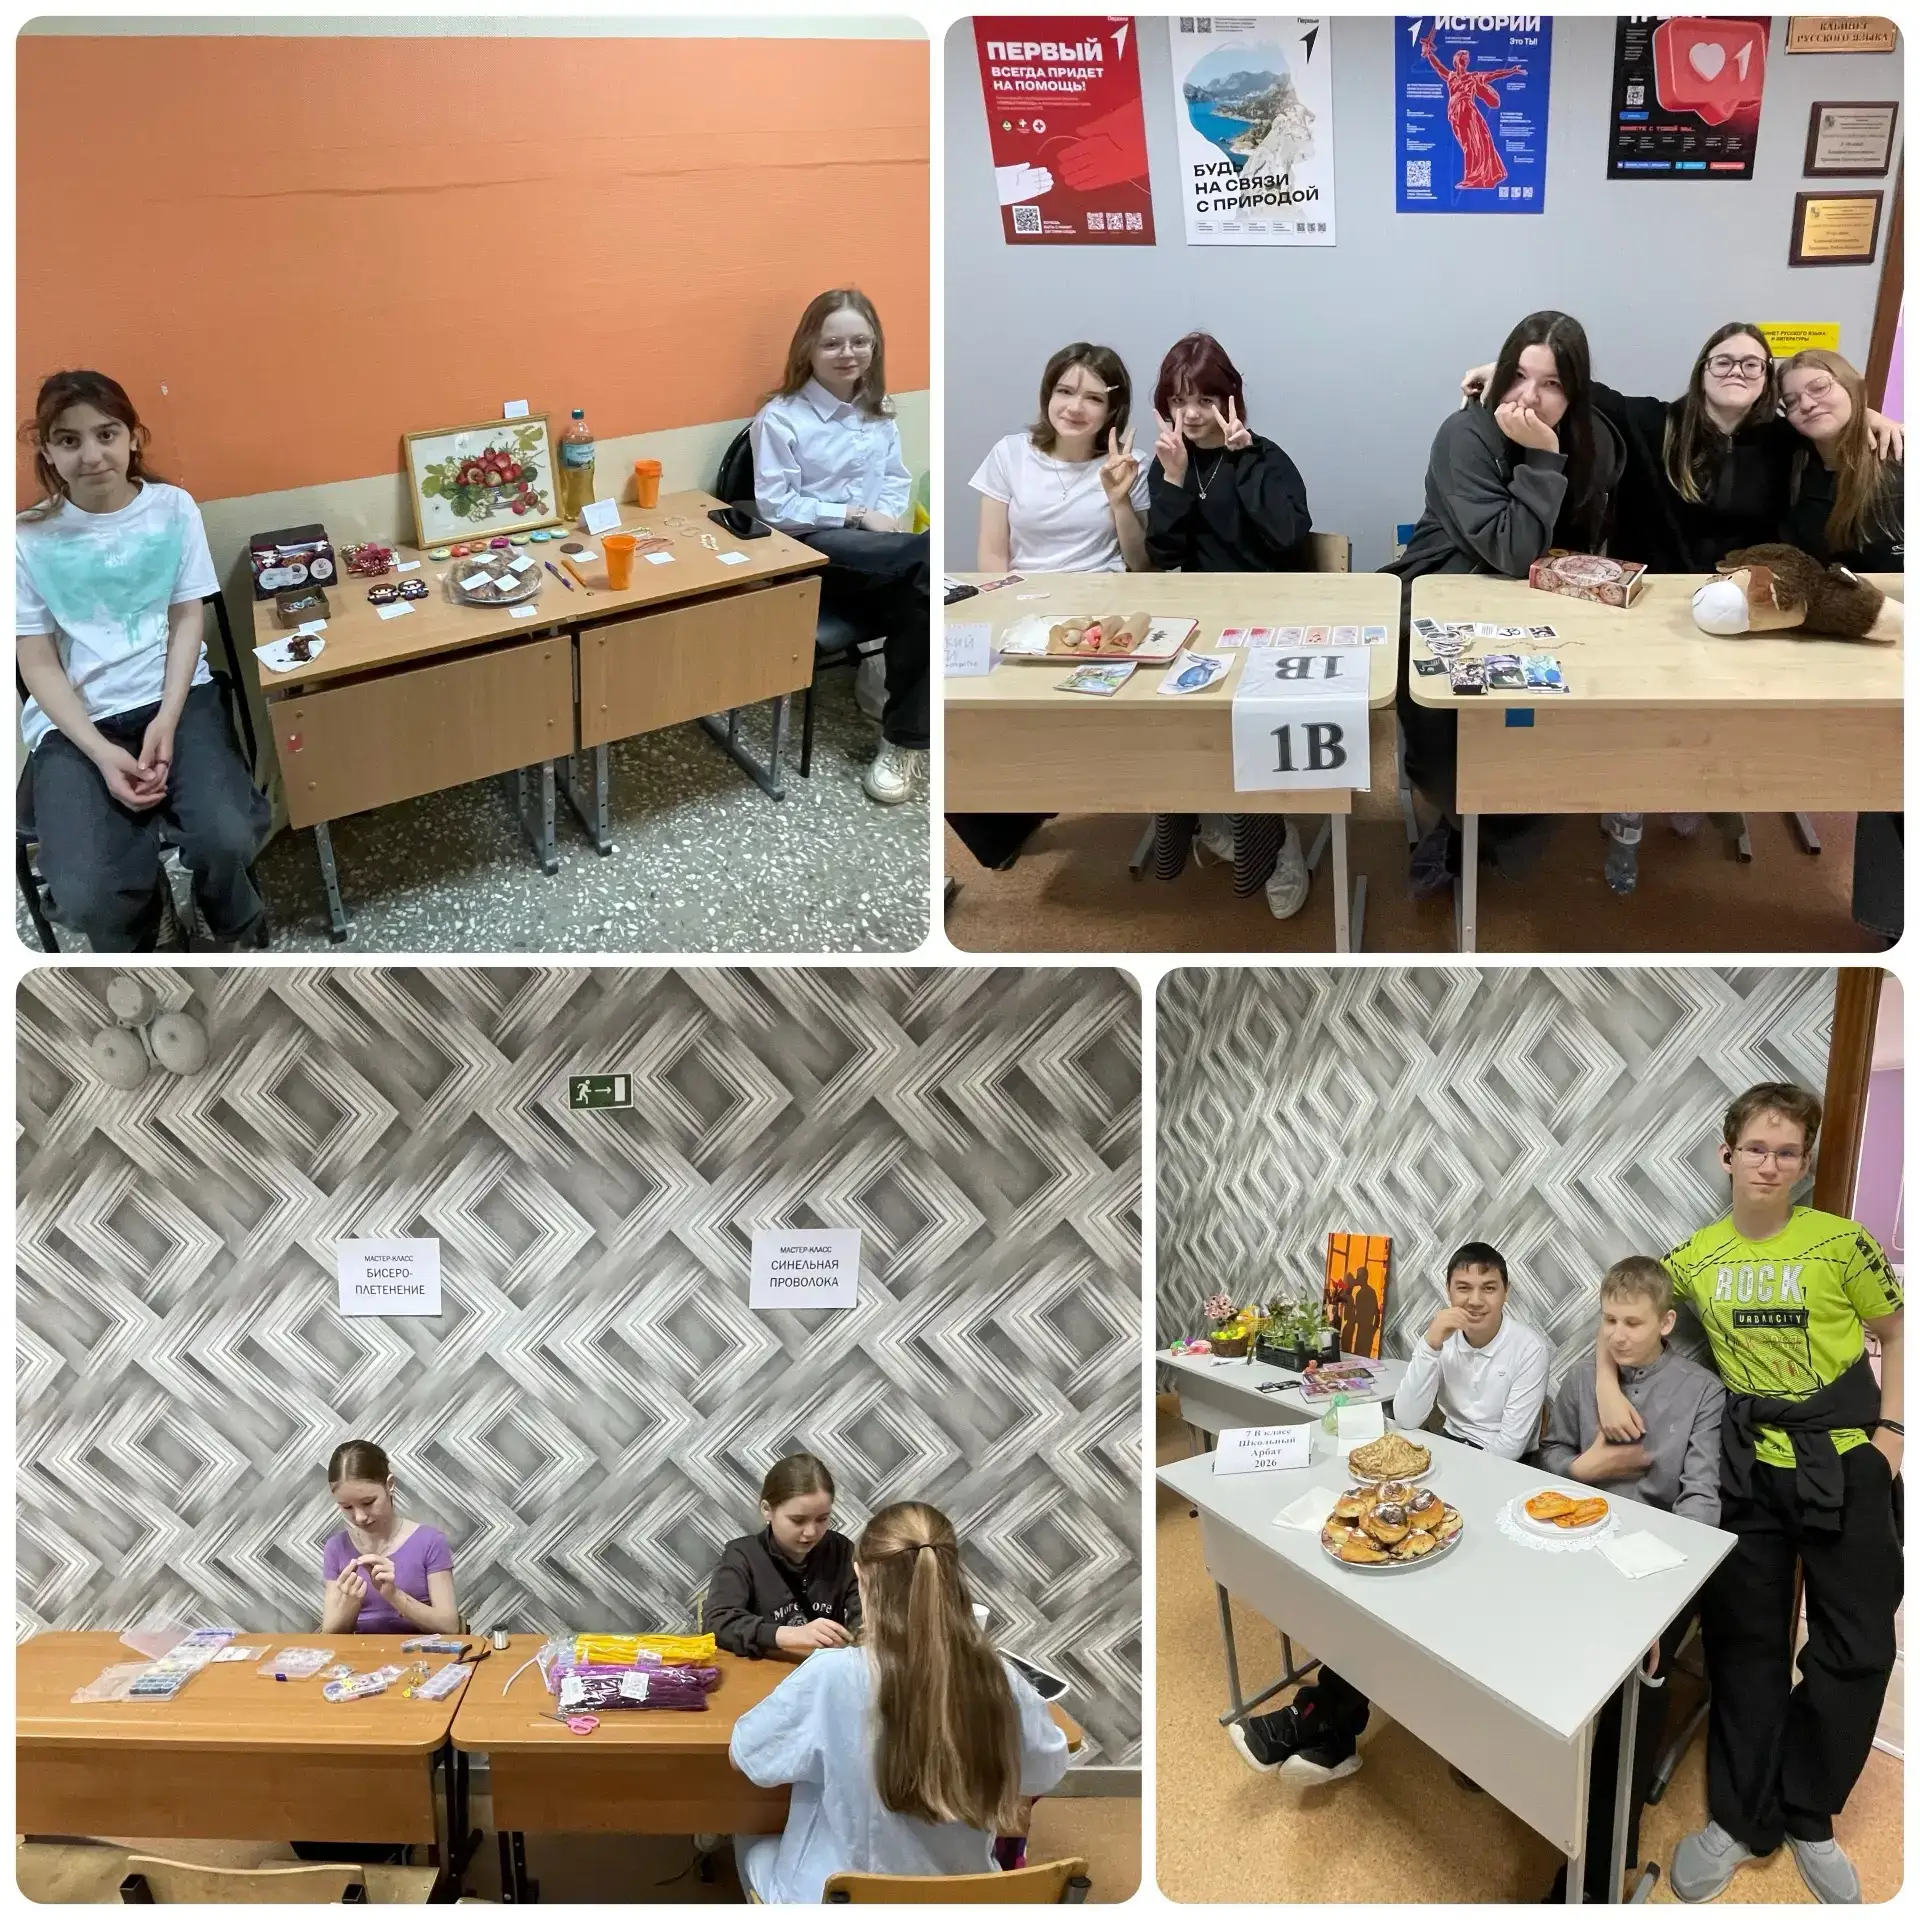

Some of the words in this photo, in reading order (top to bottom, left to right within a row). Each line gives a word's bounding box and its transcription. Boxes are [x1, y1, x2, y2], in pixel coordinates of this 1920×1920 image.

[1434, 16, 1541, 32] ИСТОРИИ
[1510, 37, 1523, 45] Это
[1797, 33, 1849, 43] РУССКОГО
[1852, 33, 1888, 42] ЯЗЫКА
[987, 37, 1103, 61] ПЕРВЫЙ
[991, 66, 1046, 79] ВСЕГДА
[1048, 67, 1104, 79] ПРИДЕТ
[993, 80, 1013, 91] НА
[1015, 80, 1087, 92] ПОМОЩЬ!
[1194, 160, 1243, 177] БУДЬ
[1195, 181, 1222, 195] НА
[1225, 174, 1289, 191] СВЯЗИ
[1196, 200, 1209, 213] С
[1213, 185, 1319, 211] ПРИРОДОЙ
[779, 1246, 832, 1254] МАСТЕР-КЛАСС
[771, 1259, 839, 1271] СИНЕЛЬНАЯ
[366, 1268, 414, 1278] БИСЕРО-
[769, 1276, 839, 1288] ПРОВОЛОКА
[1714, 1263, 1804, 1304] ROCK
[355, 1284, 426, 1295] ПЛЕТЕНЕНИЕ
[1238, 1437, 1296, 1447] Школьный
[1251, 1448, 1282, 1458] Арбат
[1254, 1459, 1277, 1468] 2026
[773, 1601, 799, 1621] More
[812, 1601, 833, 1614] ore
